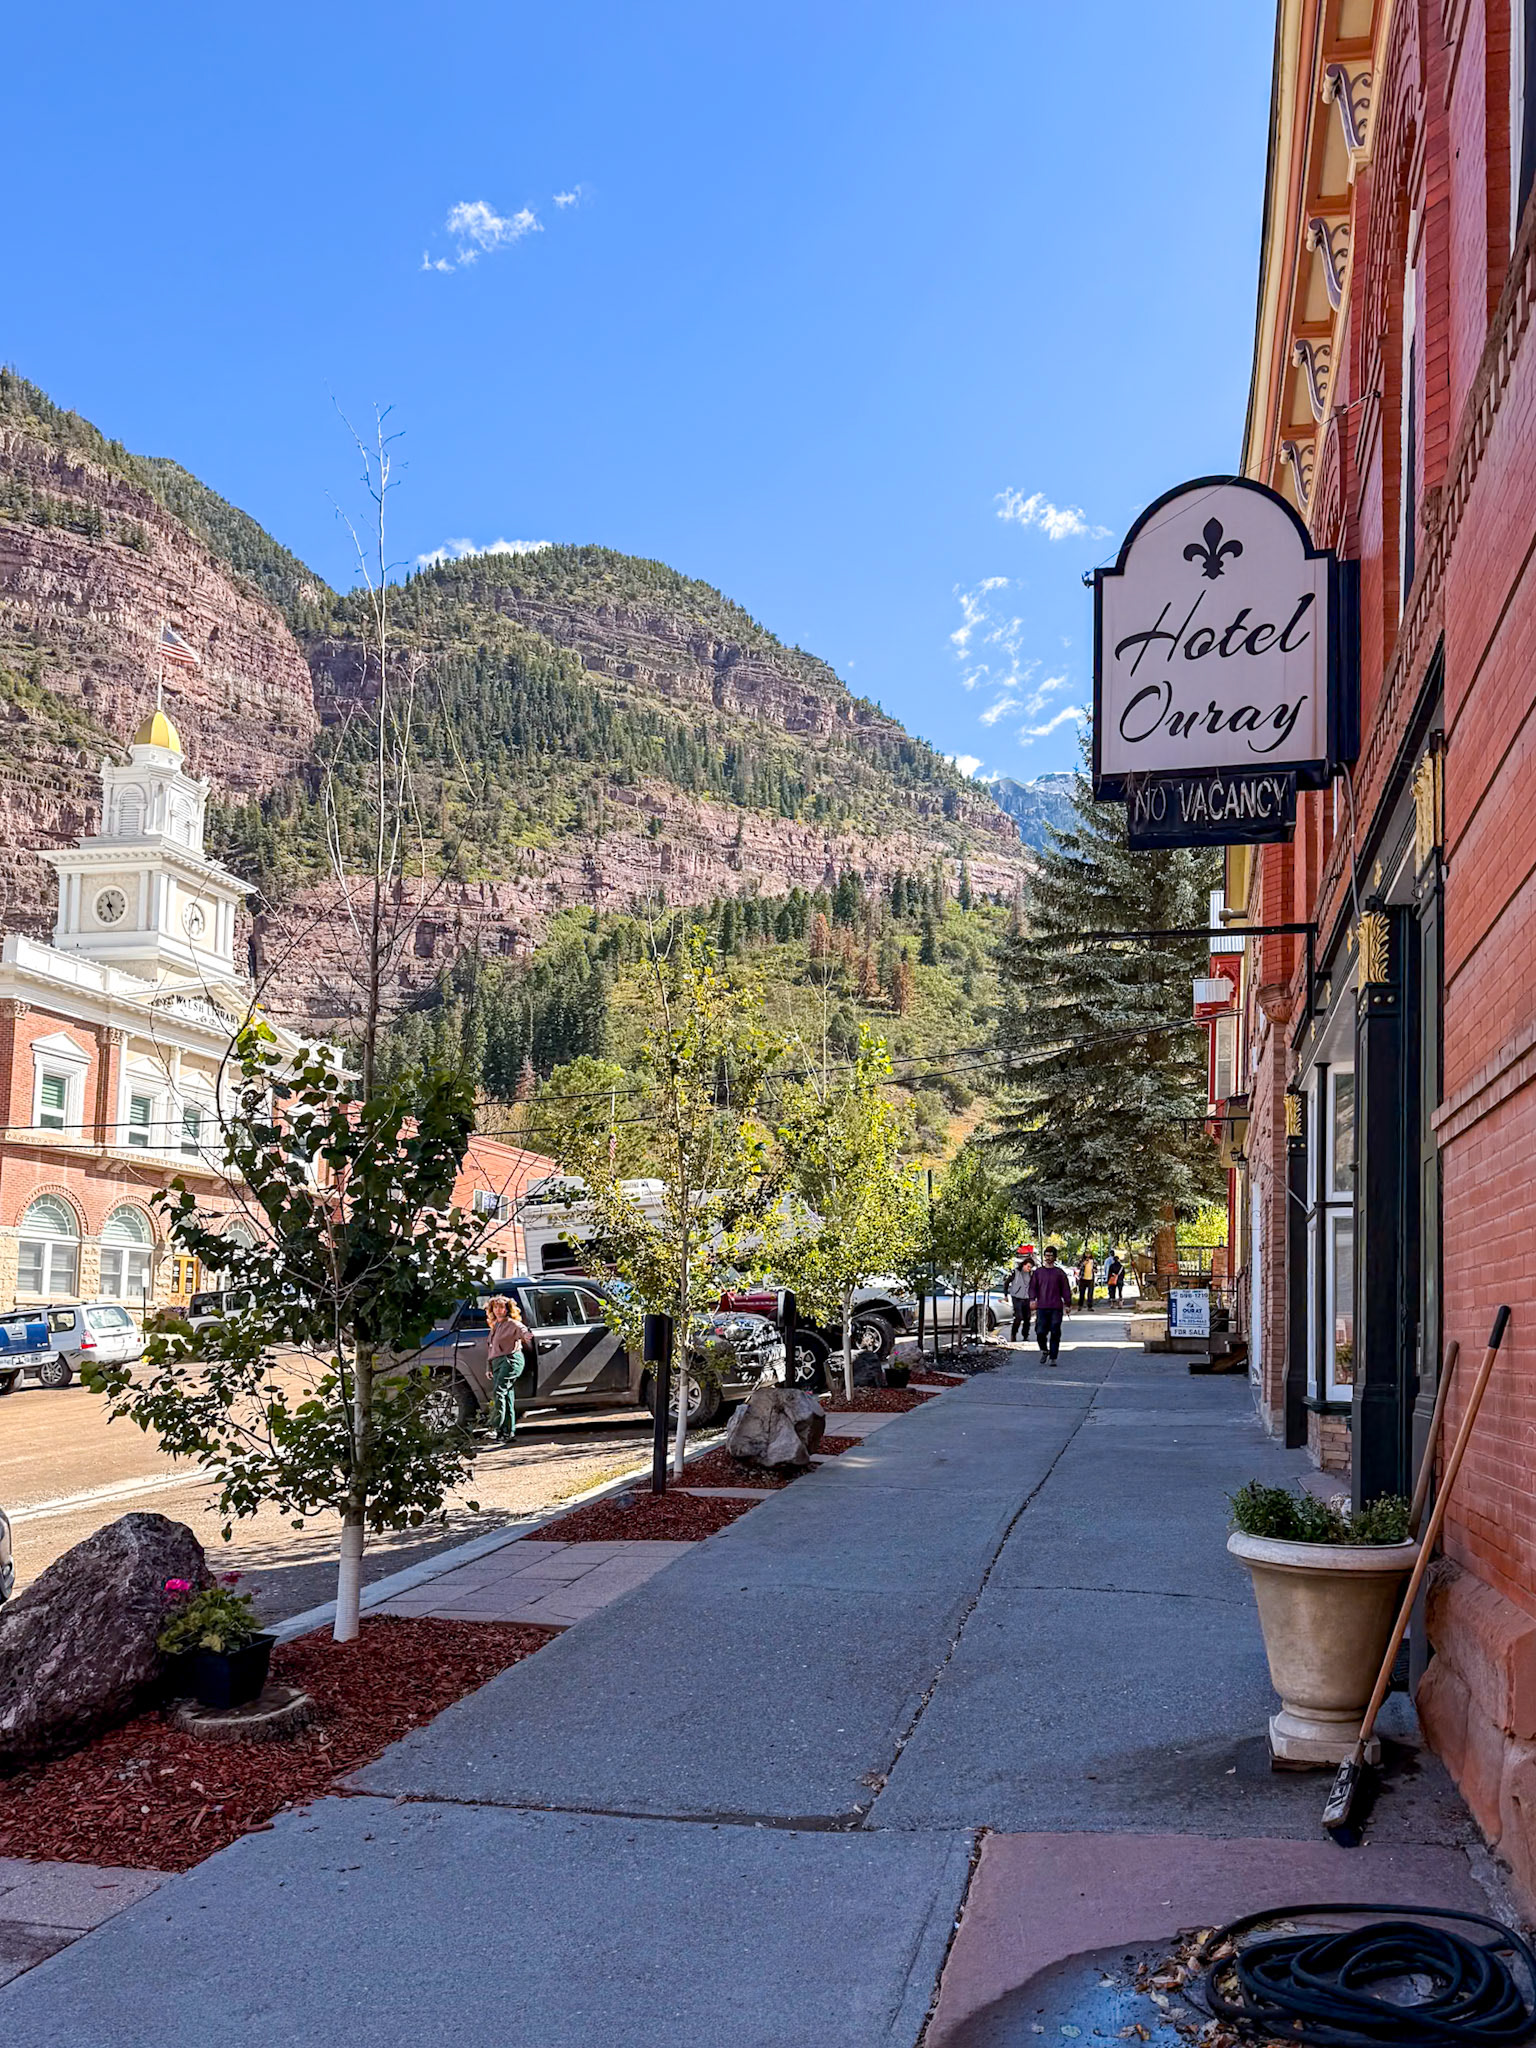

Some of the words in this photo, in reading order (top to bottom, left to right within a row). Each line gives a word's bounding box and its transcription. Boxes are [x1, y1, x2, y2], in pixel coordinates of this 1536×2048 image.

[1114, 590, 1316, 677] Hotel
[1119, 680, 1308, 753] Ouray
[1135, 786, 1167, 821] NO
[1180, 777, 1288, 822] VACANCY
[176, 994, 204, 1013] WALSH
